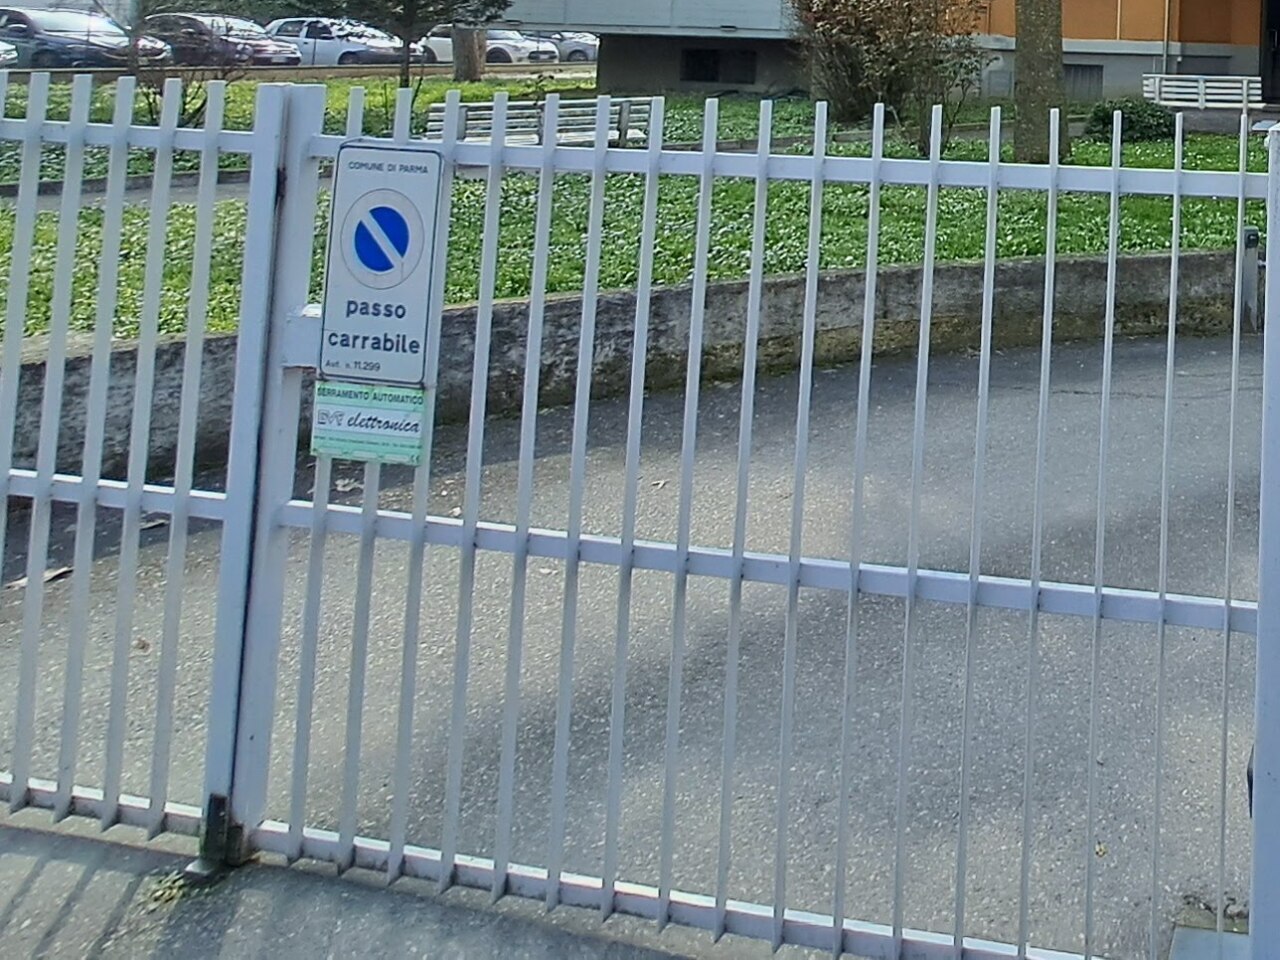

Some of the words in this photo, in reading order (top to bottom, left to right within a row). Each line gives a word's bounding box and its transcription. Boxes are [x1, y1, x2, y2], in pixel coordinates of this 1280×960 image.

[348, 161, 384, 172] COMUNE
[387, 163, 397, 172] DI
[399, 164, 428, 174] PARMA
[346, 300, 406, 319] passo
[328, 331, 421, 354] carrabile
[317, 387, 369, 400] SERRAMENTO
[372, 392, 424, 405] AUTOMATICO
[347, 411, 420, 434] elettronica
